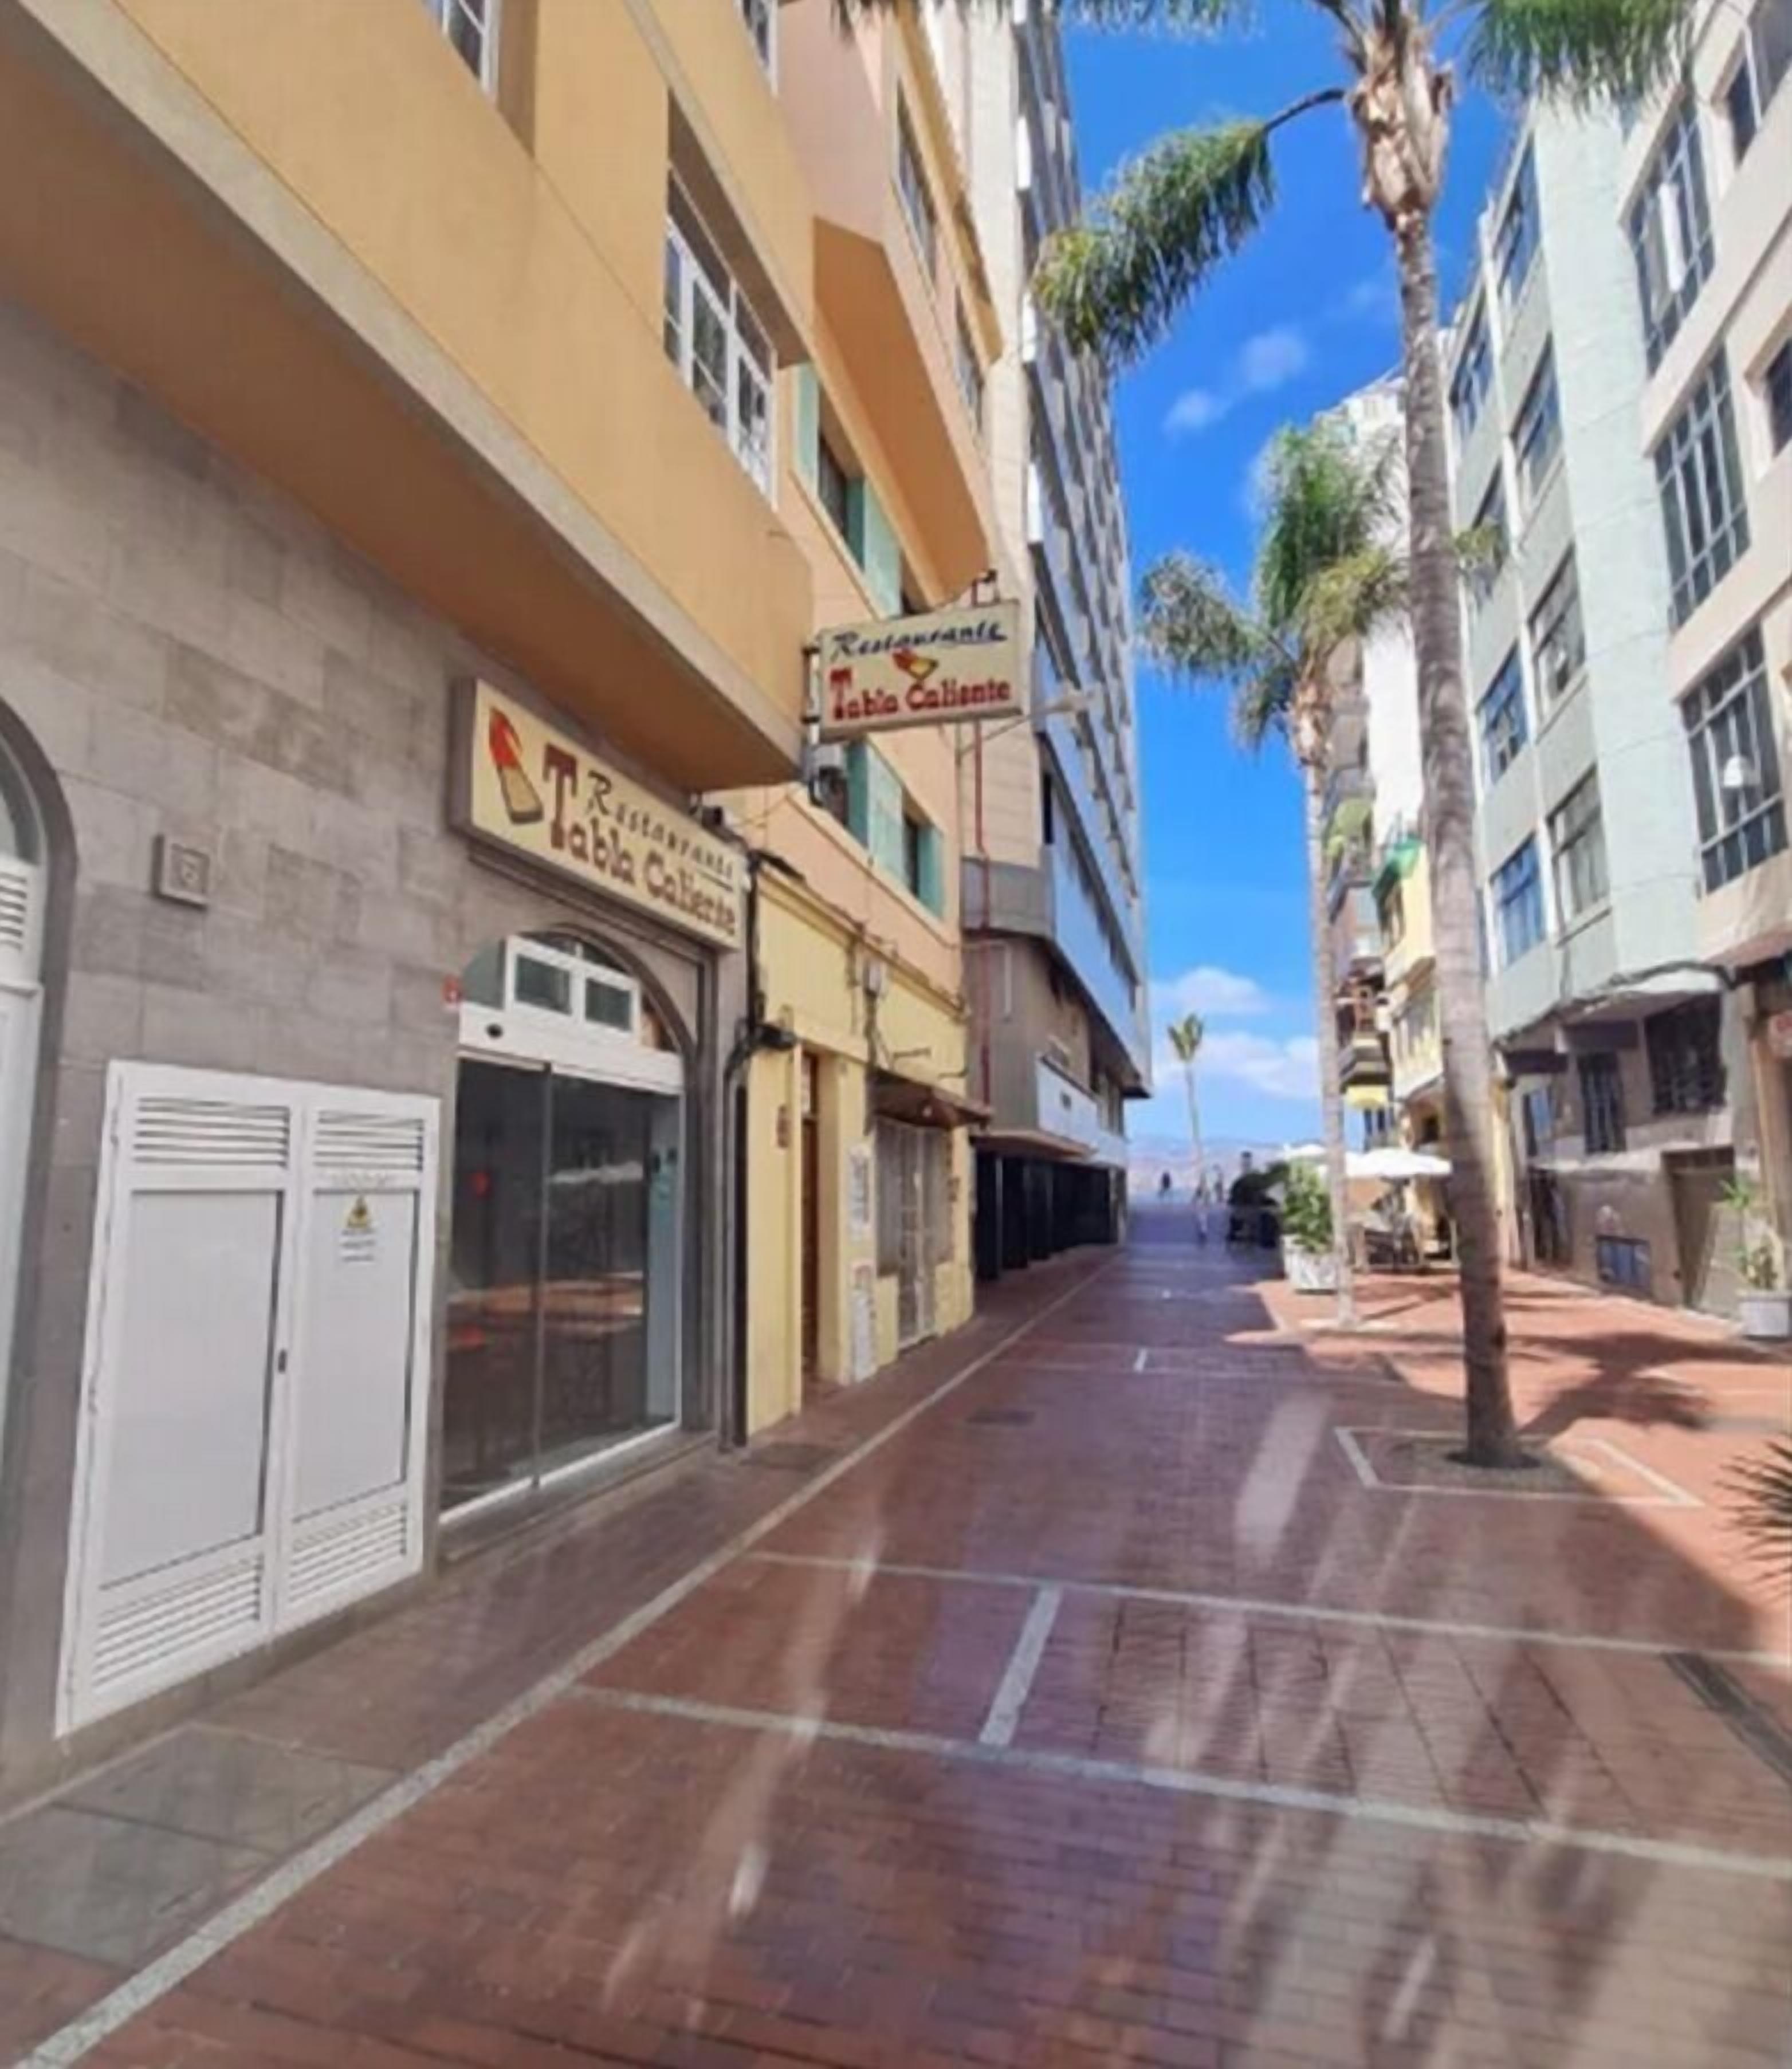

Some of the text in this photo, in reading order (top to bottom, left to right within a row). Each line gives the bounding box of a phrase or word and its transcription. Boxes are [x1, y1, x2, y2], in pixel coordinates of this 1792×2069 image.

[831, 621, 1007, 660] Restaurante
[830, 668, 1010, 719] Tabla Caliente
[544, 744, 735, 935] Tabla Caliente
[587, 771, 733, 878] Restaurante
